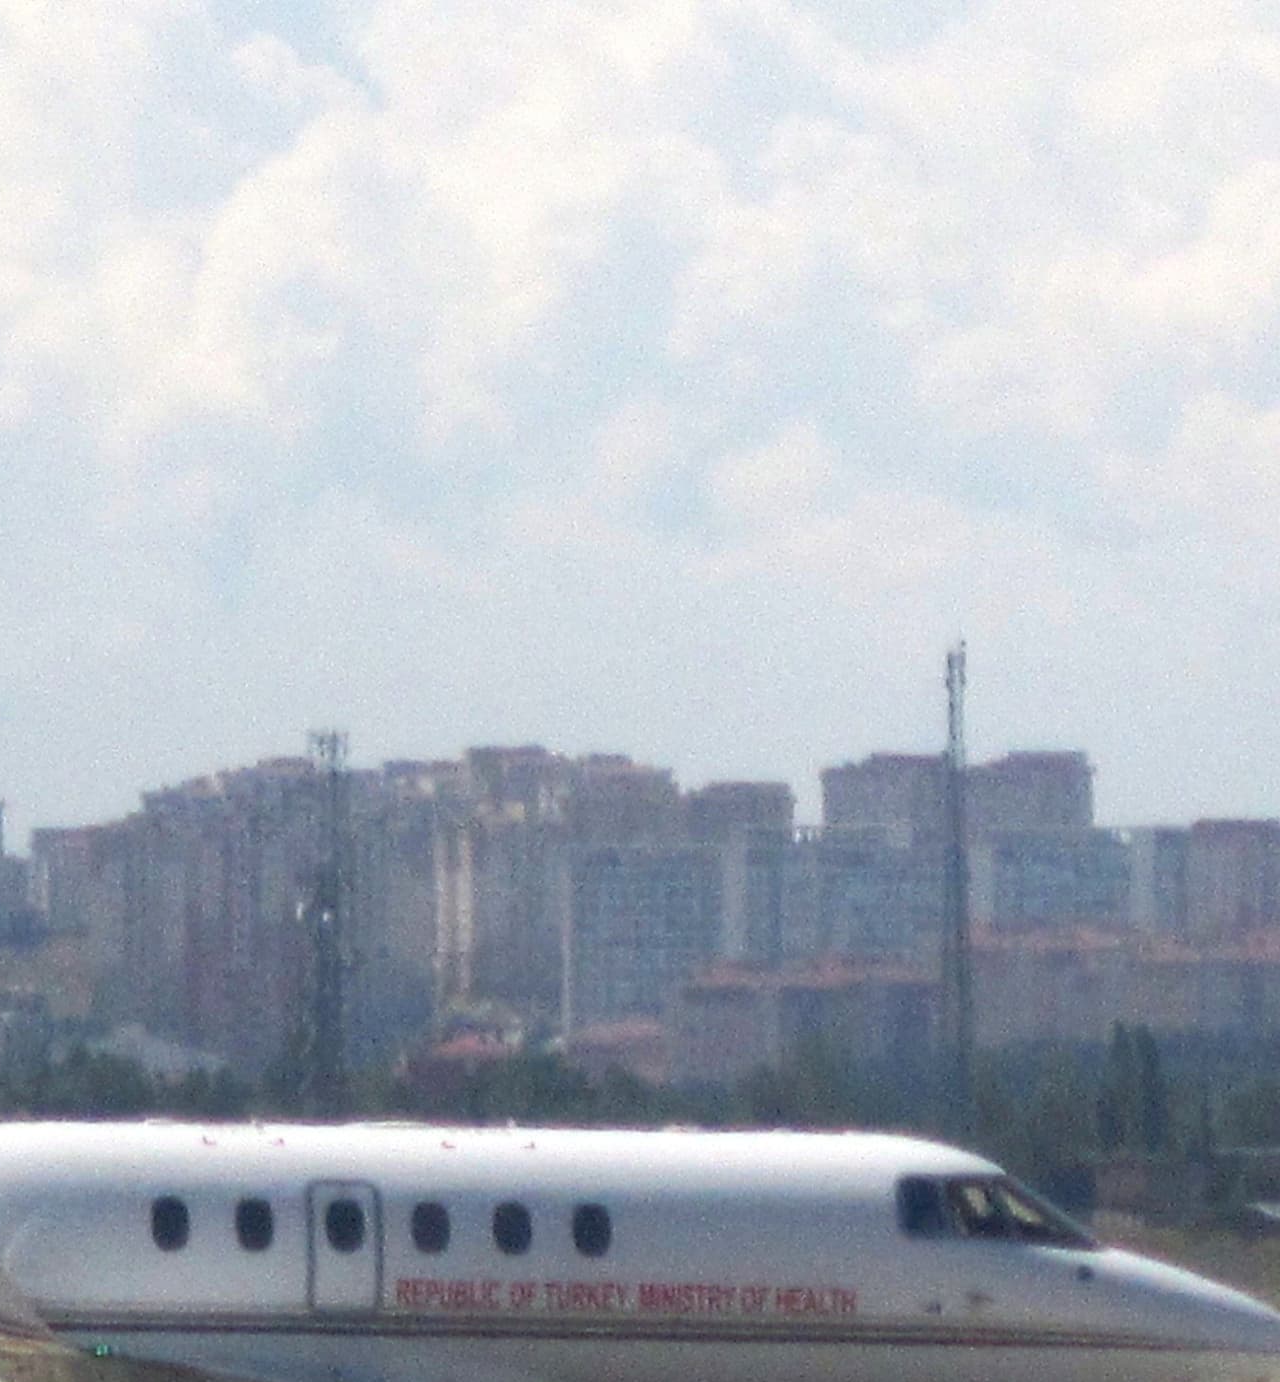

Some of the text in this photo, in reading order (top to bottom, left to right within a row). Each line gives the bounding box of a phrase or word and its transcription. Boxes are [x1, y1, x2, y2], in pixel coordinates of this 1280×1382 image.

[396, 1277, 858, 1316] REPUBLIC OF TURKEY MINISTRY OF HEALTH
